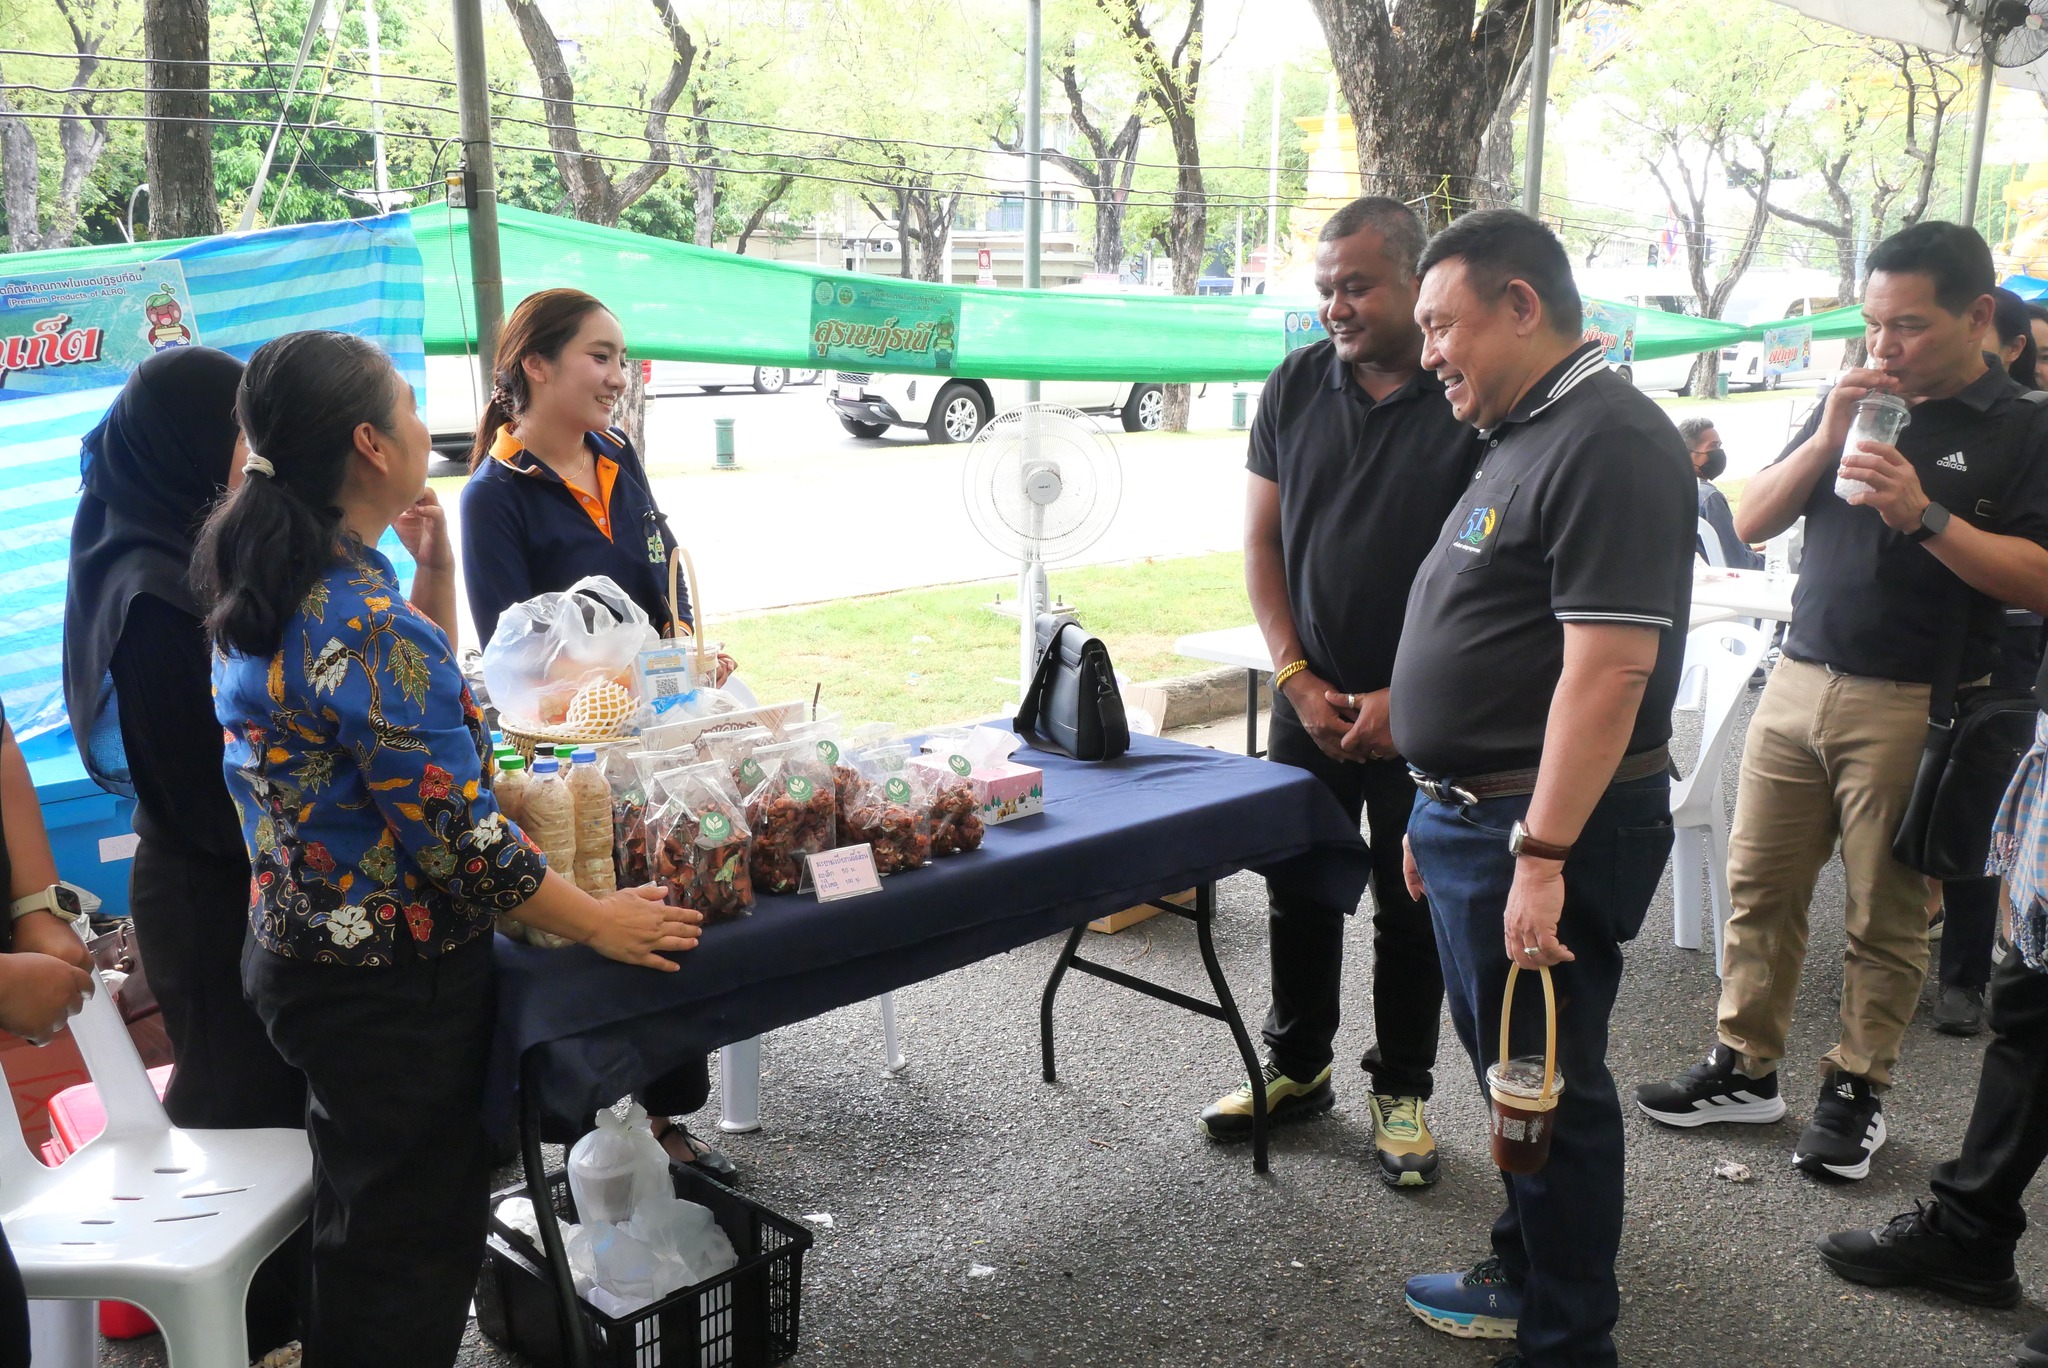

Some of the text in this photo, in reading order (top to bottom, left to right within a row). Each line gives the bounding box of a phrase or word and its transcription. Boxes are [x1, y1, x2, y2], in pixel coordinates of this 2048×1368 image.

[8, 287, 126, 308] (Premium Products of ALRO)
[1936, 459, 1968, 472] adidas
